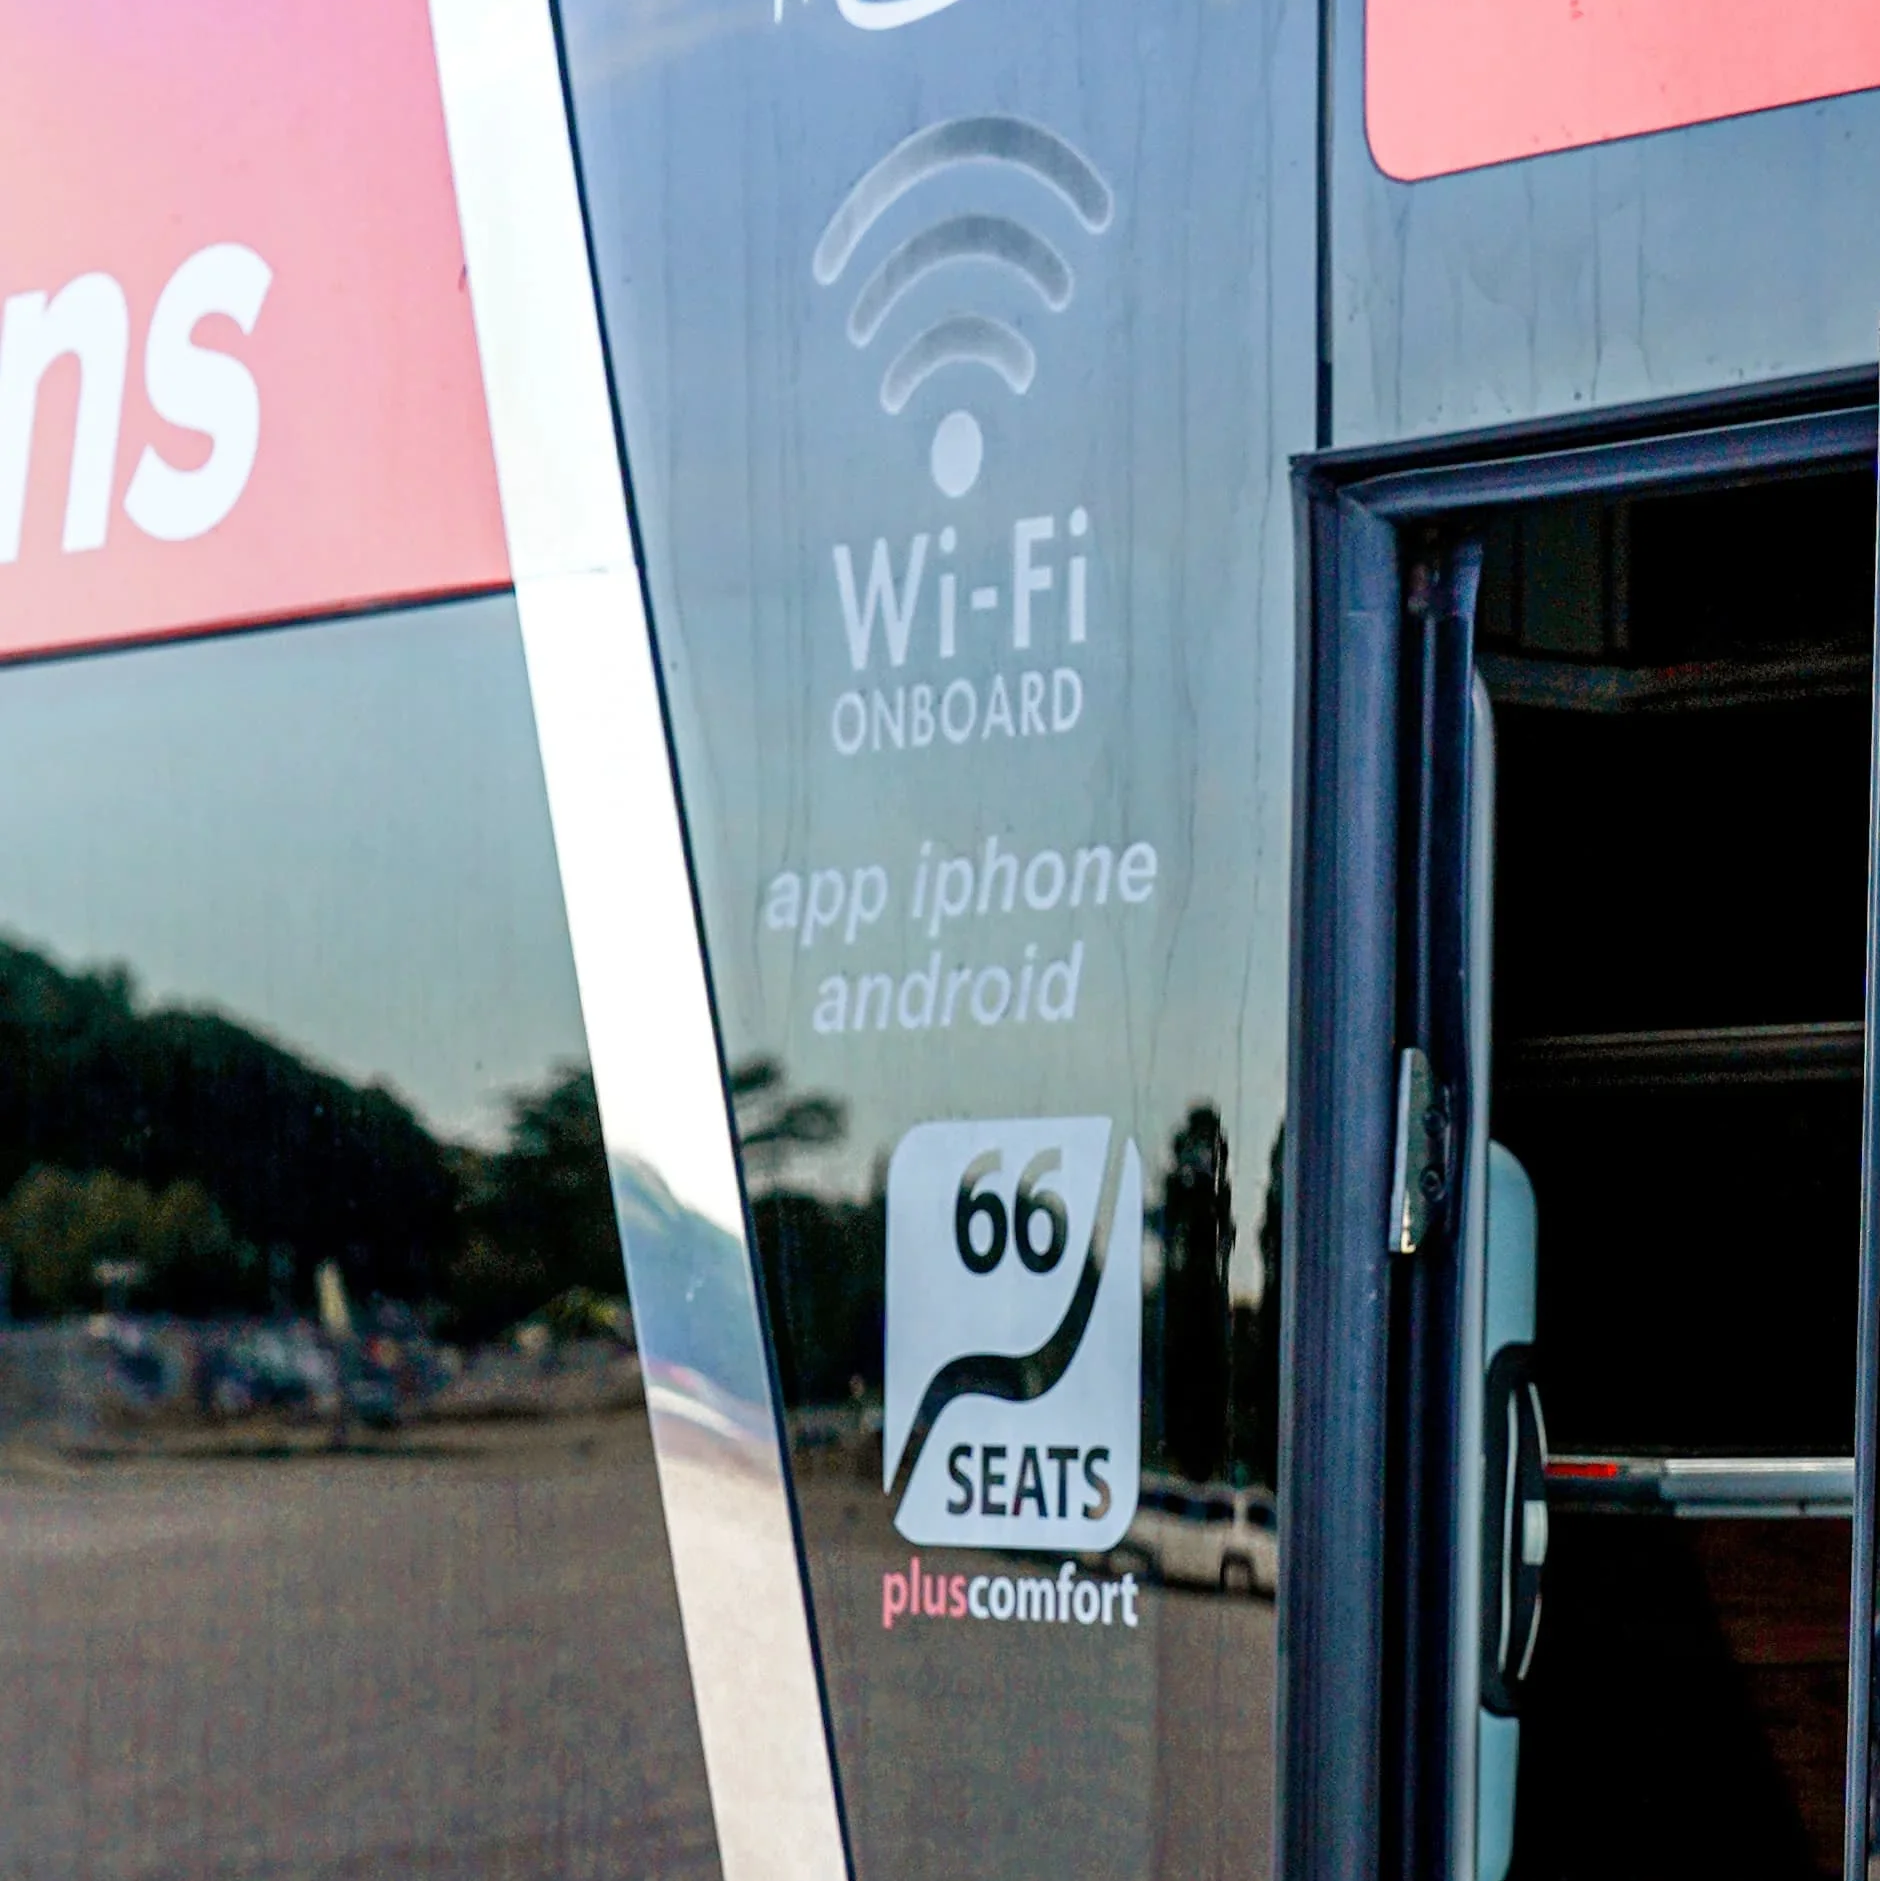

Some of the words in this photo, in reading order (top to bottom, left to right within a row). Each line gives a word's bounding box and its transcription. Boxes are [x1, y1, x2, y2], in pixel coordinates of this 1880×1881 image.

[0, 241, 274, 564] ns
[832, 505, 1089, 671] Wi-Fi
[831, 667, 1083, 755] ONBOARD
[763, 863, 888, 947] app
[911, 835, 1159, 939] iphone
[811, 939, 1084, 1036] android
[954, 1146, 1069, 1275] 66
[945, 1442, 1111, 1521] SEATS
[882, 1555, 1139, 1630] pluscomfort
